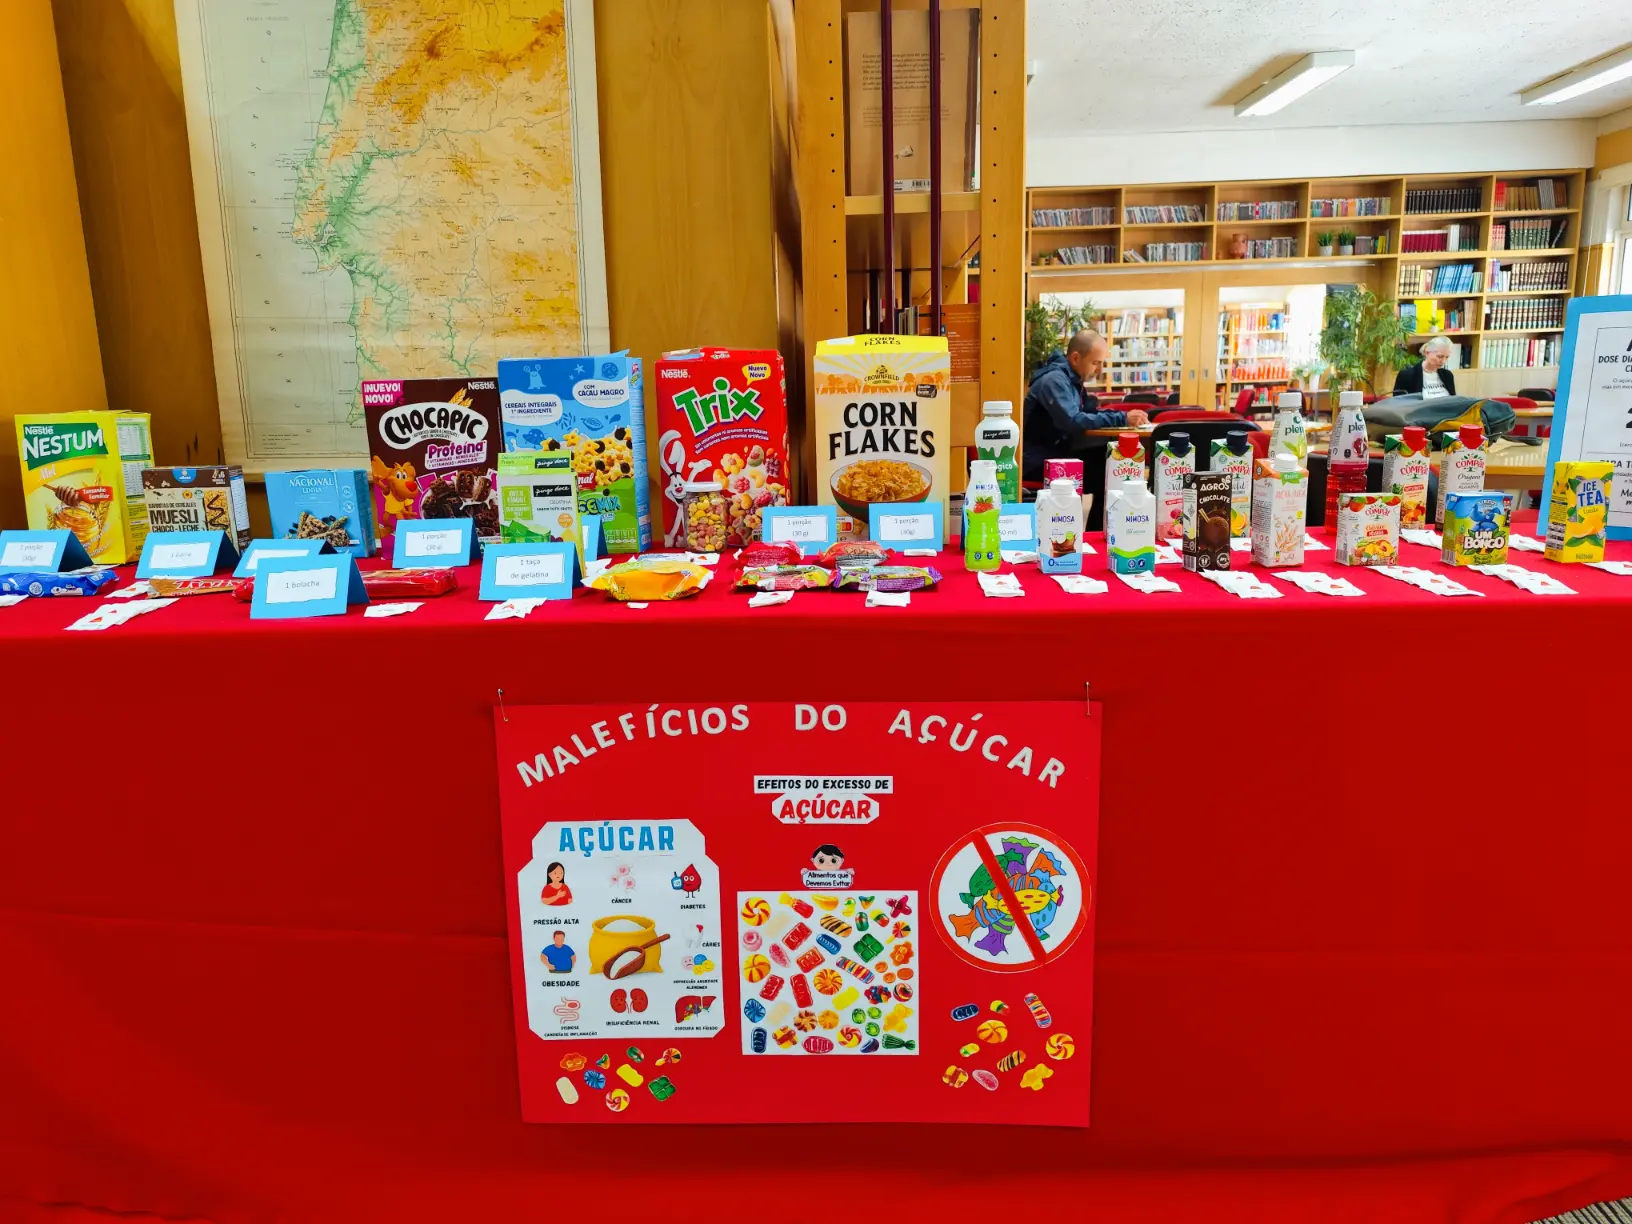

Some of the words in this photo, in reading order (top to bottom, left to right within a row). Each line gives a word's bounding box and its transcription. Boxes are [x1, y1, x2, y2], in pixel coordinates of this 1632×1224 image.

[1598, 356, 1619, 364] DOSE
[661, 369, 688, 378] Nestlé
[468, 381, 494, 390] Nestlé
[365, 394, 394, 403] NOVO!
[672, 377, 764, 437] Trix
[843, 402, 918, 428] CORN
[25, 426, 53, 435] Nestlé
[384, 407, 482, 444] CHOCAPIC
[22, 428, 104, 460] NESTUM
[428, 440, 484, 458] Proteína
[828, 427, 936, 460] FLAKES
[289, 477, 335, 487] NACIONAL
[578, 474, 594, 484] nal
[1583, 481, 1596, 492] ICE
[1200, 494, 1230, 504] CHOCOLATE
[1578, 490, 1603, 507] TEA
[150, 509, 199, 525] MUESLI
[1475, 530, 1492, 540] UM
[1464, 536, 1506, 549] BONGO
[526, 558, 541, 567] taça
[521, 571, 549, 582] gelatina
[292, 580, 320, 588] bolacha
[516, 704, 750, 788] MALEFÍCIOS
[794, 704, 848, 731] DO
[888, 709, 1066, 788] AÇÚCAR
[757, 779, 802, 790] EFEITOS
[804, 779, 819, 790] DO
[822, 779, 872, 790] EXCESSO
[875, 778, 889, 790] DE
[779, 794, 872, 824] AÇÚCAR
[559, 822, 674, 857] AÇÚCAR
[807, 871, 835, 880] Alimentos
[534, 917, 561, 925] PRESSÃO
